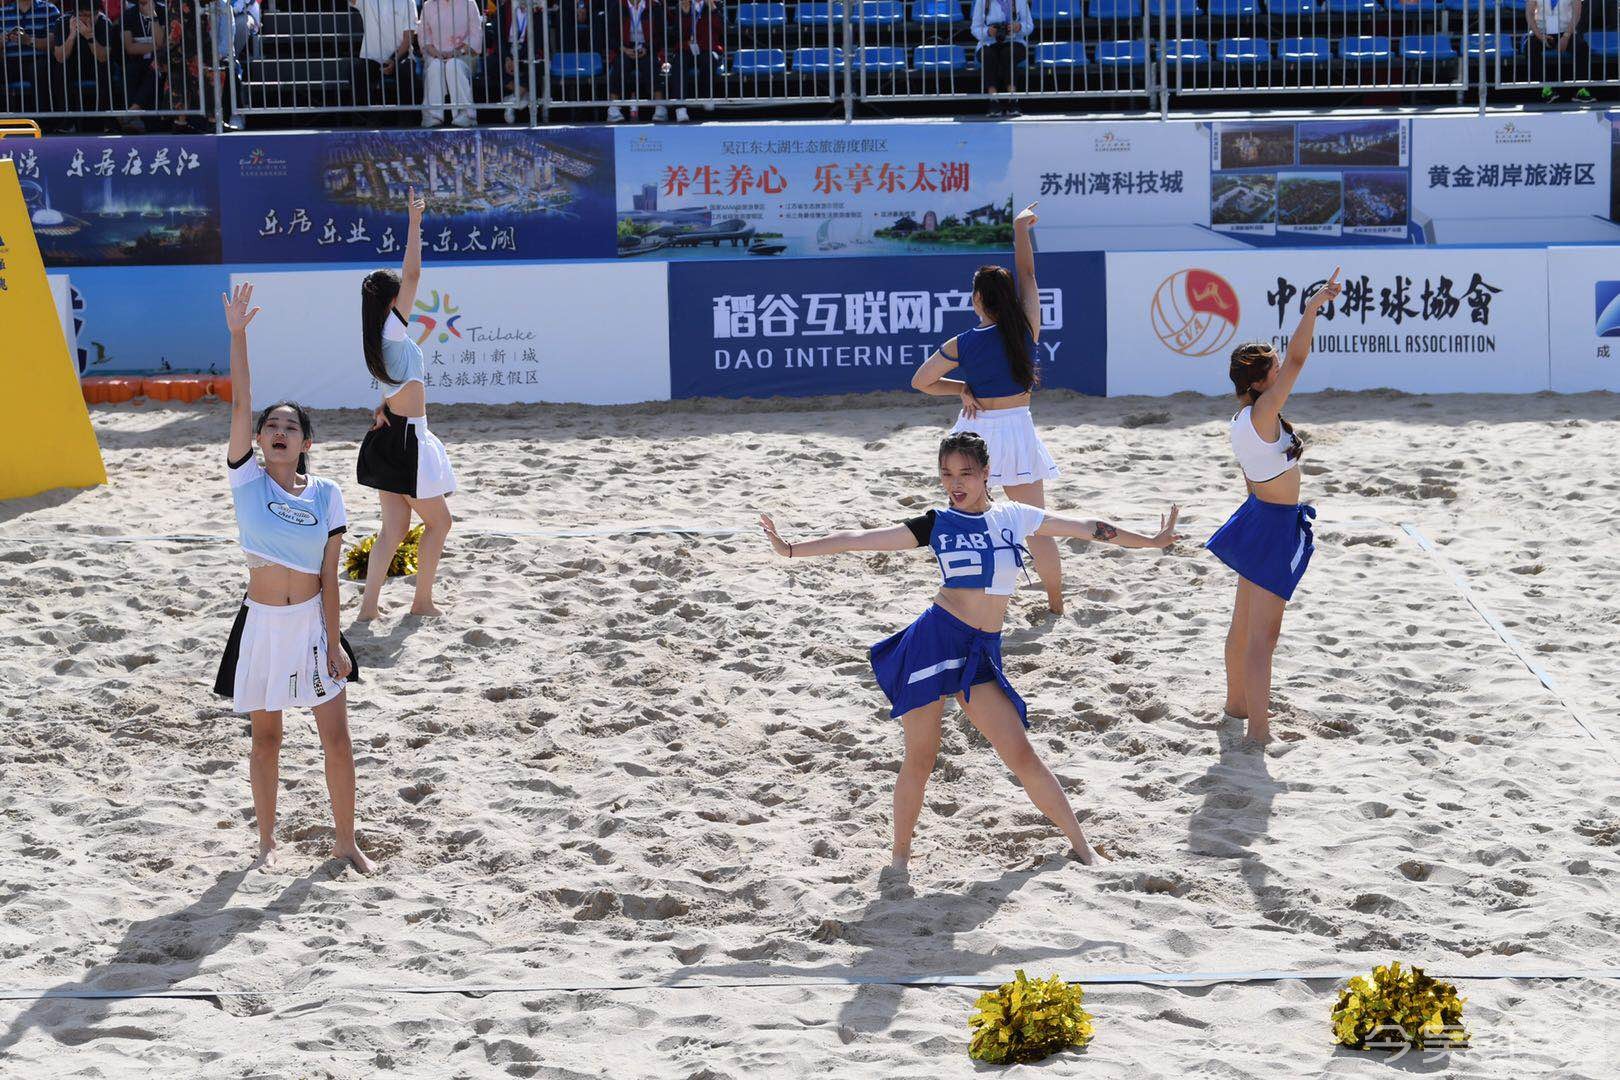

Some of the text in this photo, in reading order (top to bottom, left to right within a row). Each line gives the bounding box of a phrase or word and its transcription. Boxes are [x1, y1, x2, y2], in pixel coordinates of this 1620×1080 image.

[722, 139, 888, 154] 吴江东太湖生态旅游度假区
[67, 148, 200, 177] 乐居在吴江
[662, 162, 970, 197] 养生养心 乐享东太湖
[1040, 170, 1183, 195] 苏州湾科技城
[1428, 163, 1595, 188] 黄金湖岸旅游区
[259, 208, 516, 254] 乐居 乐业 乐东太湖
[713, 288, 1063, 338] 稻谷互联网产园
[1319, 334, 1401, 353] VOLLEYBALL
[1405, 334, 1496, 353] ASSOCIATION
[714, 344, 934, 369] DAO INTERNET
